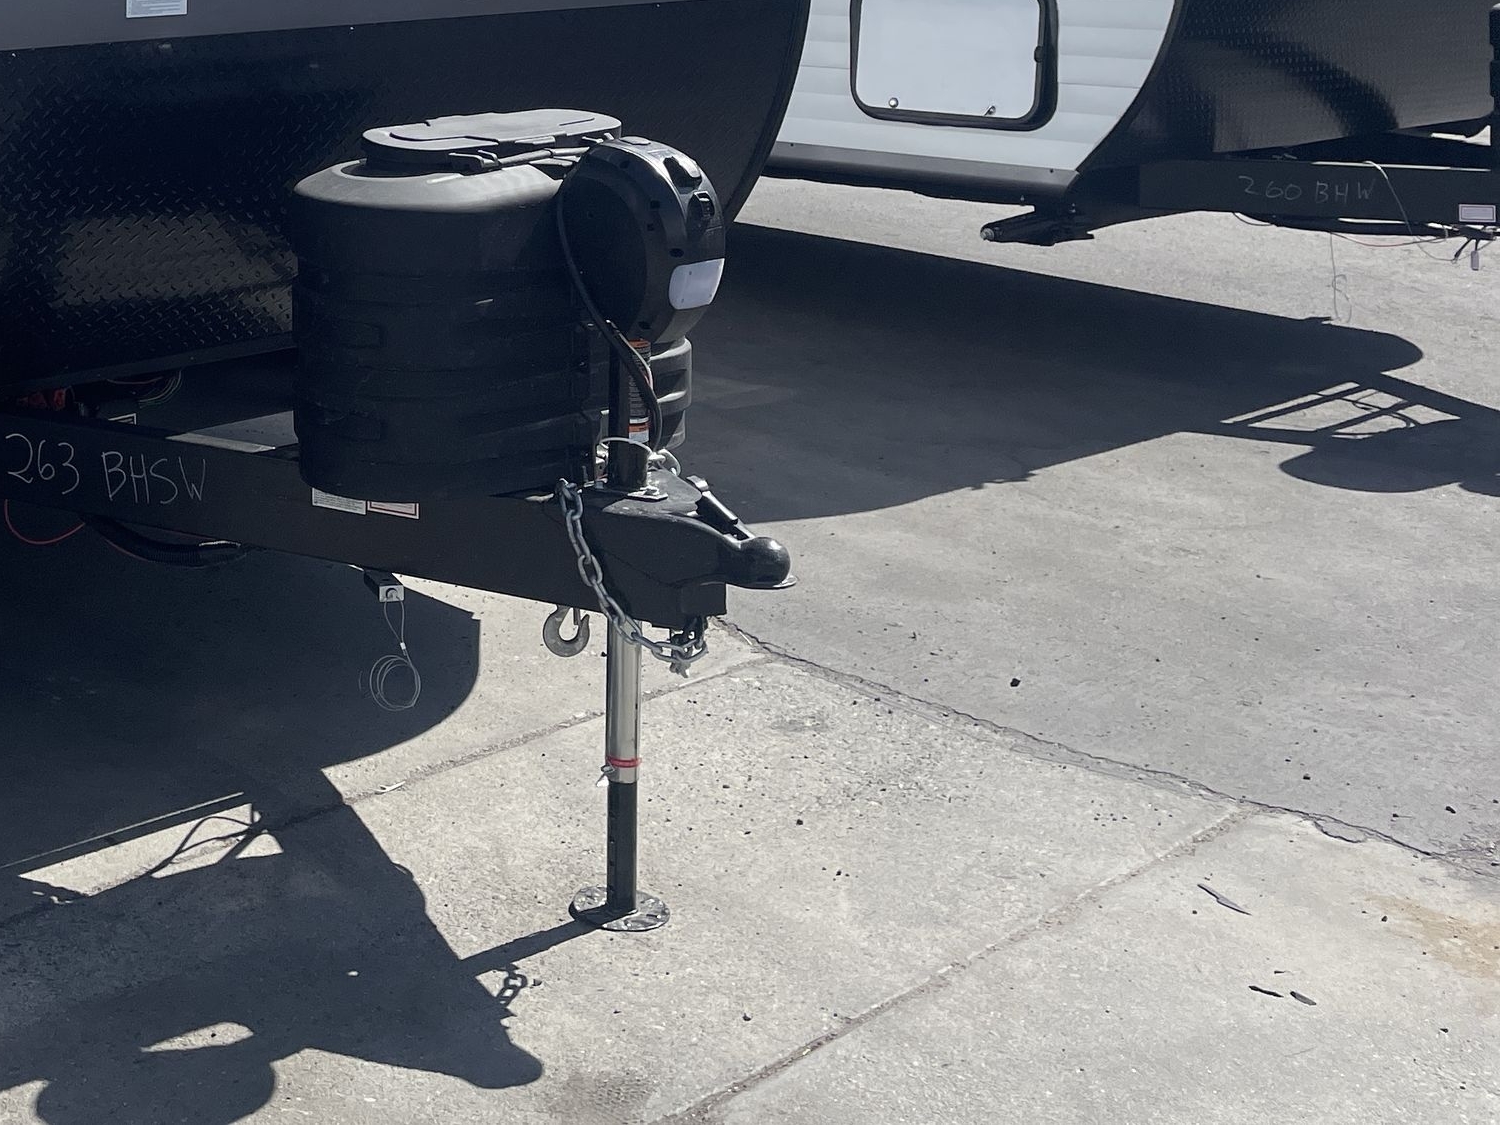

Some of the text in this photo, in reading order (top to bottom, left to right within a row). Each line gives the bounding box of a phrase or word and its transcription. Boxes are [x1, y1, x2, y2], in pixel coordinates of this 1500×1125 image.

[1237, 175, 1377, 204] 260 BHW
[5, 432, 206, 504] 263 BHSW
